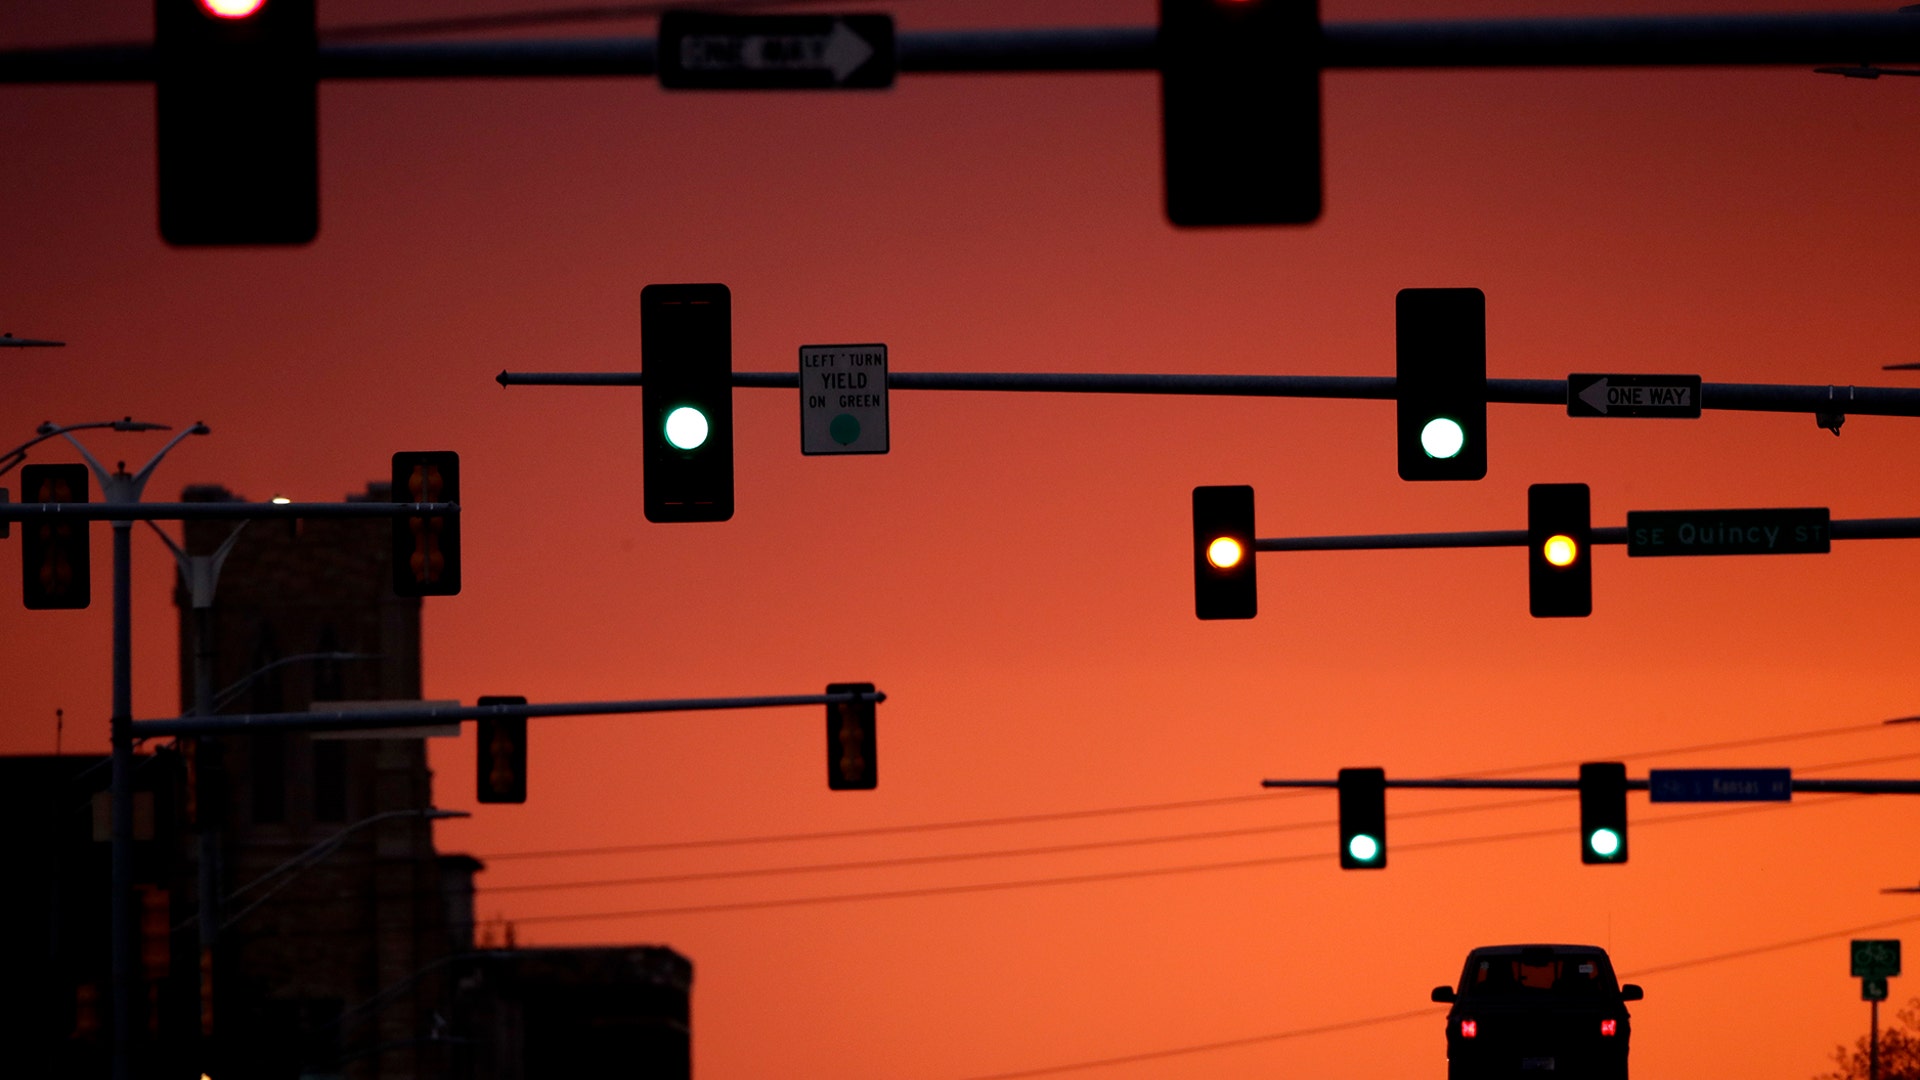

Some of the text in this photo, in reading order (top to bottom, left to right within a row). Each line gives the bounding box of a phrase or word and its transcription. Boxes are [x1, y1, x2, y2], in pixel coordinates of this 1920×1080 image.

[805, 353, 882, 367] LEFT TURN
[821, 372, 867, 389] YIELD
[809, 395, 880, 408] ON GREEN
[1607, 388, 1686, 404] ONE WAY
[1635, 521, 1824, 549] SE Quincy ST
[1712, 778, 1760, 796] Kansas
